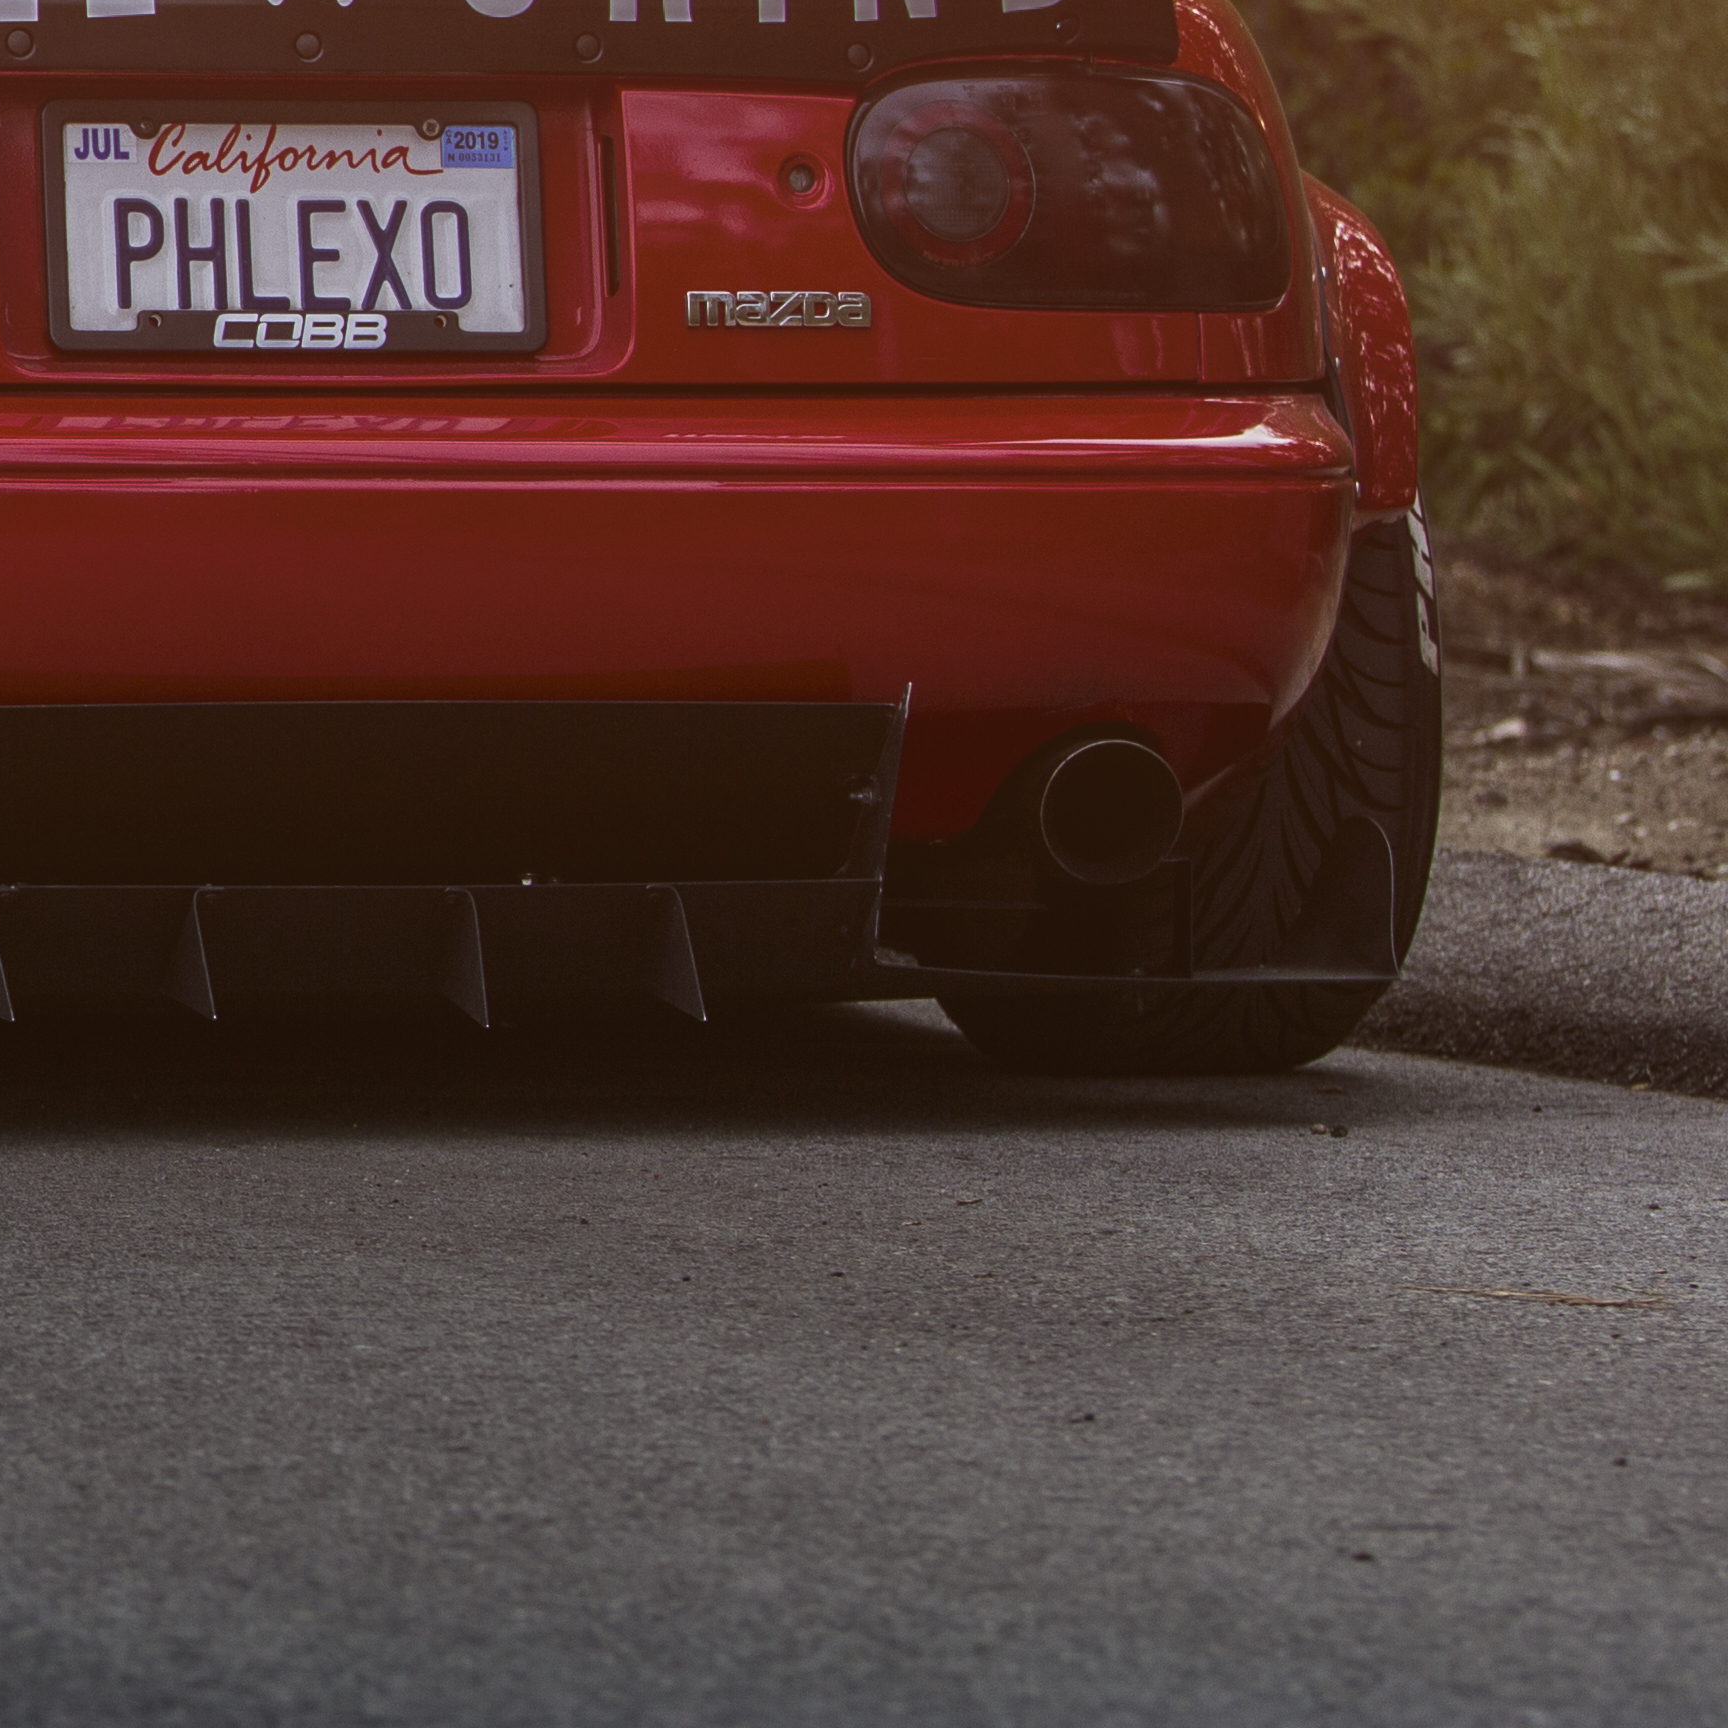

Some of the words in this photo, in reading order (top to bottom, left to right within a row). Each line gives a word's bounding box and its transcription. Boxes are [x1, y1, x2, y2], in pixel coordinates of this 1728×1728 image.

[74, 128, 130, 160] JUL
[148, 122, 443, 194] California
[453, 131, 499, 150] 2019
[113, 197, 473, 312] PHLEXO
[687, 291, 872, 327] mazda
[213, 313, 388, 349] COBB
